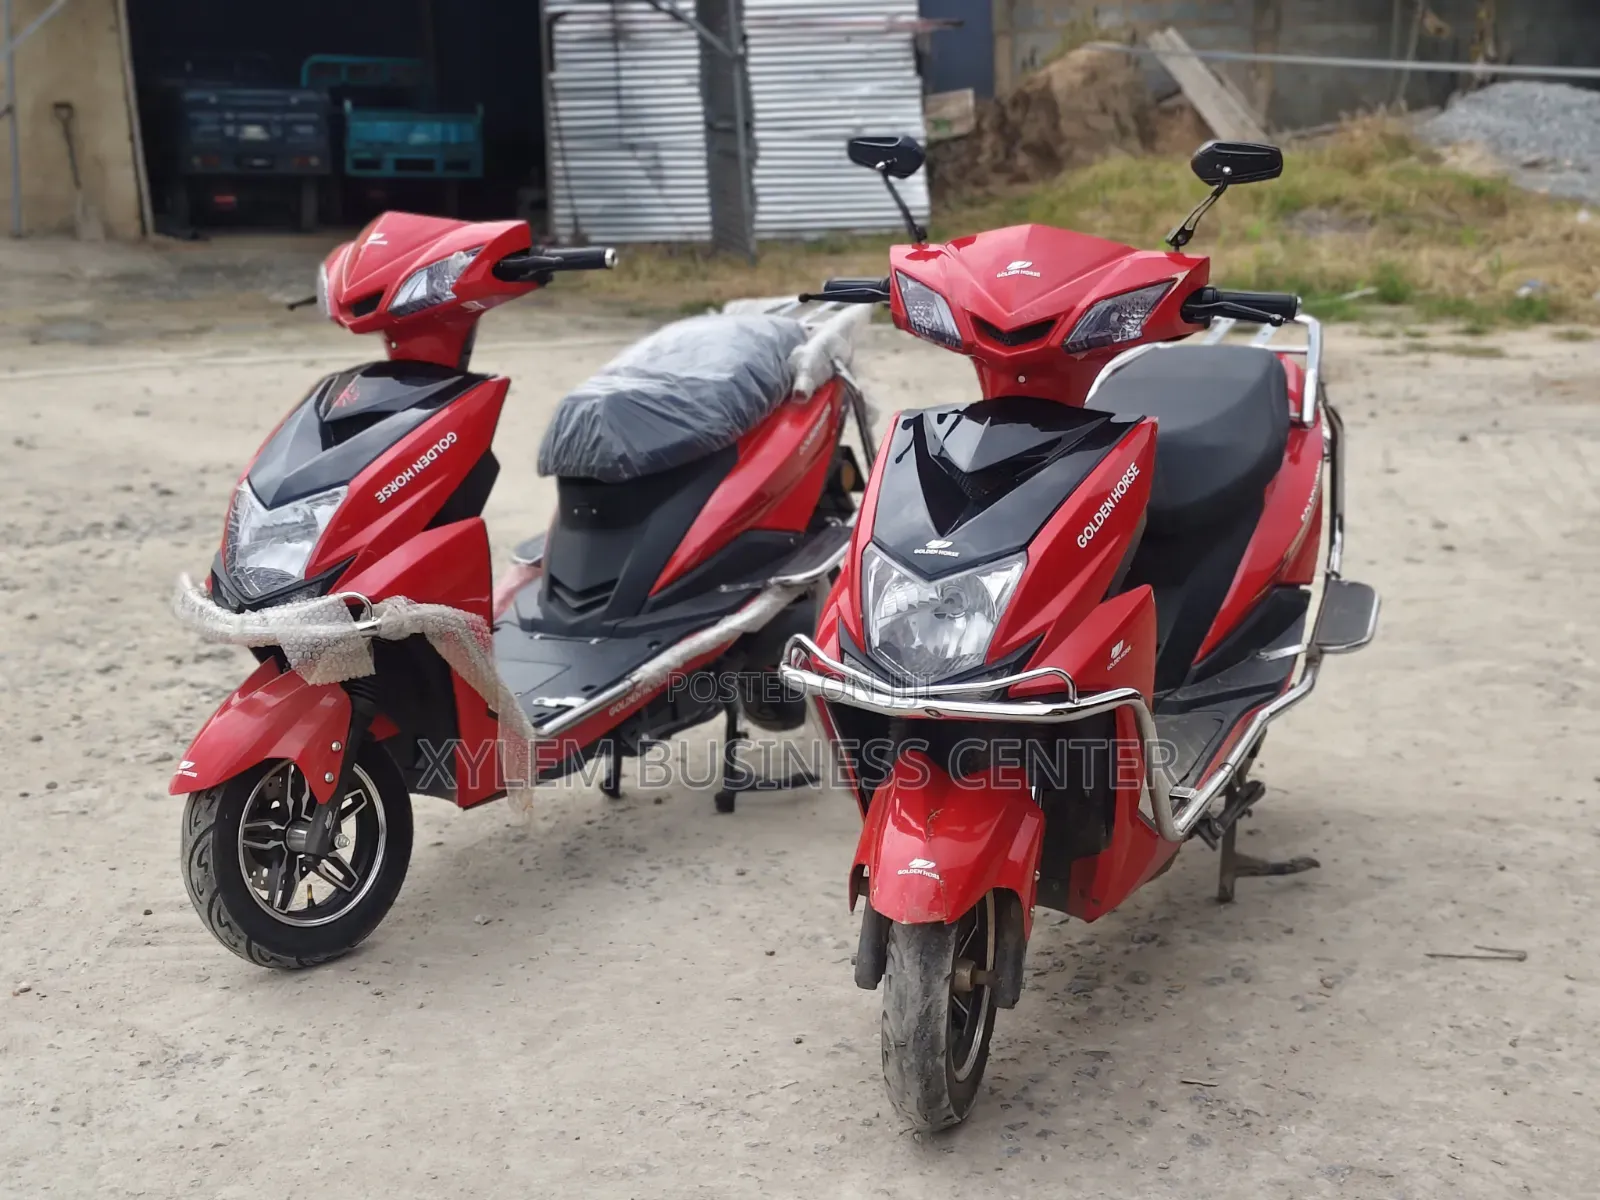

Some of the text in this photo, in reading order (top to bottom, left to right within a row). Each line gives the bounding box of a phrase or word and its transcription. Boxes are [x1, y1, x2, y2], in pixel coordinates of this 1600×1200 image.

[996, 269, 1020, 278] GOLDEN
[374, 431, 457, 504] GOLDEN HORSE
[1076, 461, 1140, 549] GOLDEN HORSE
[938, 549, 960, 558] HORSE
[922, 870, 940, 880] HORS
